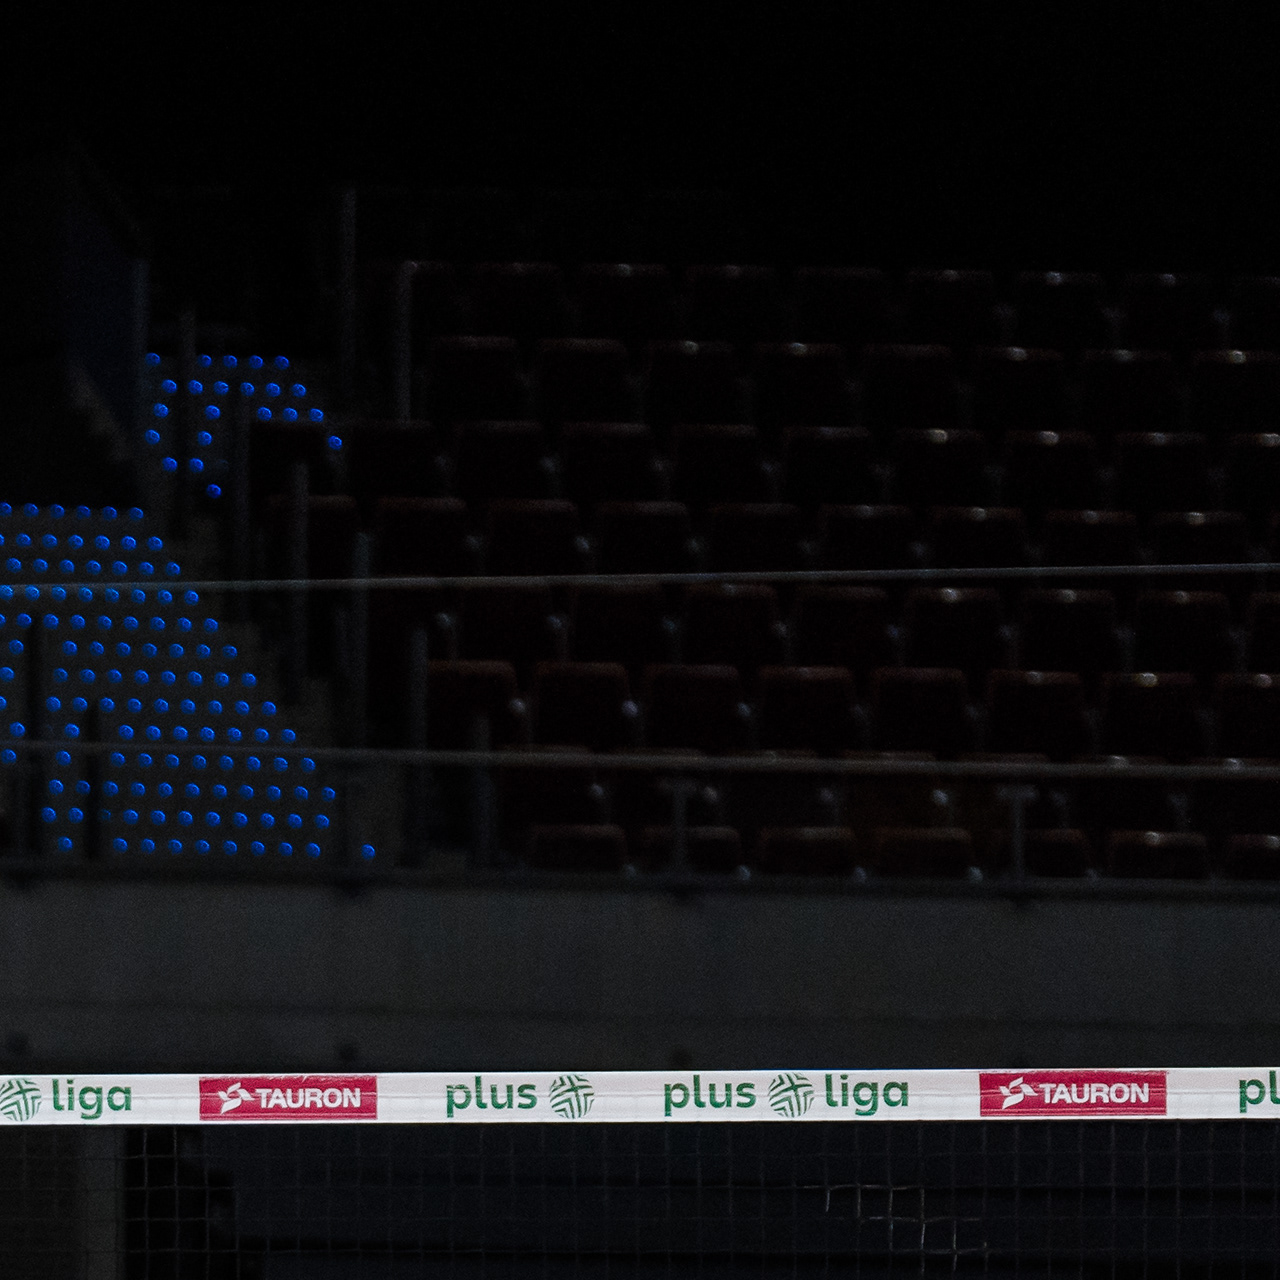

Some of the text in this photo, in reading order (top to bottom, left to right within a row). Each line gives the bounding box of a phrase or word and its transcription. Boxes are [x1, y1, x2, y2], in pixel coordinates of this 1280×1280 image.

[51, 1079, 132, 1119] liga
[257, 1087, 361, 1108] TAURON
[446, 1076, 537, 1118] plus
[664, 1074, 909, 1117] plus liga
[1038, 1082, 1149, 1104] TAURON
[1239, 1070, 1280, 1113] pl
